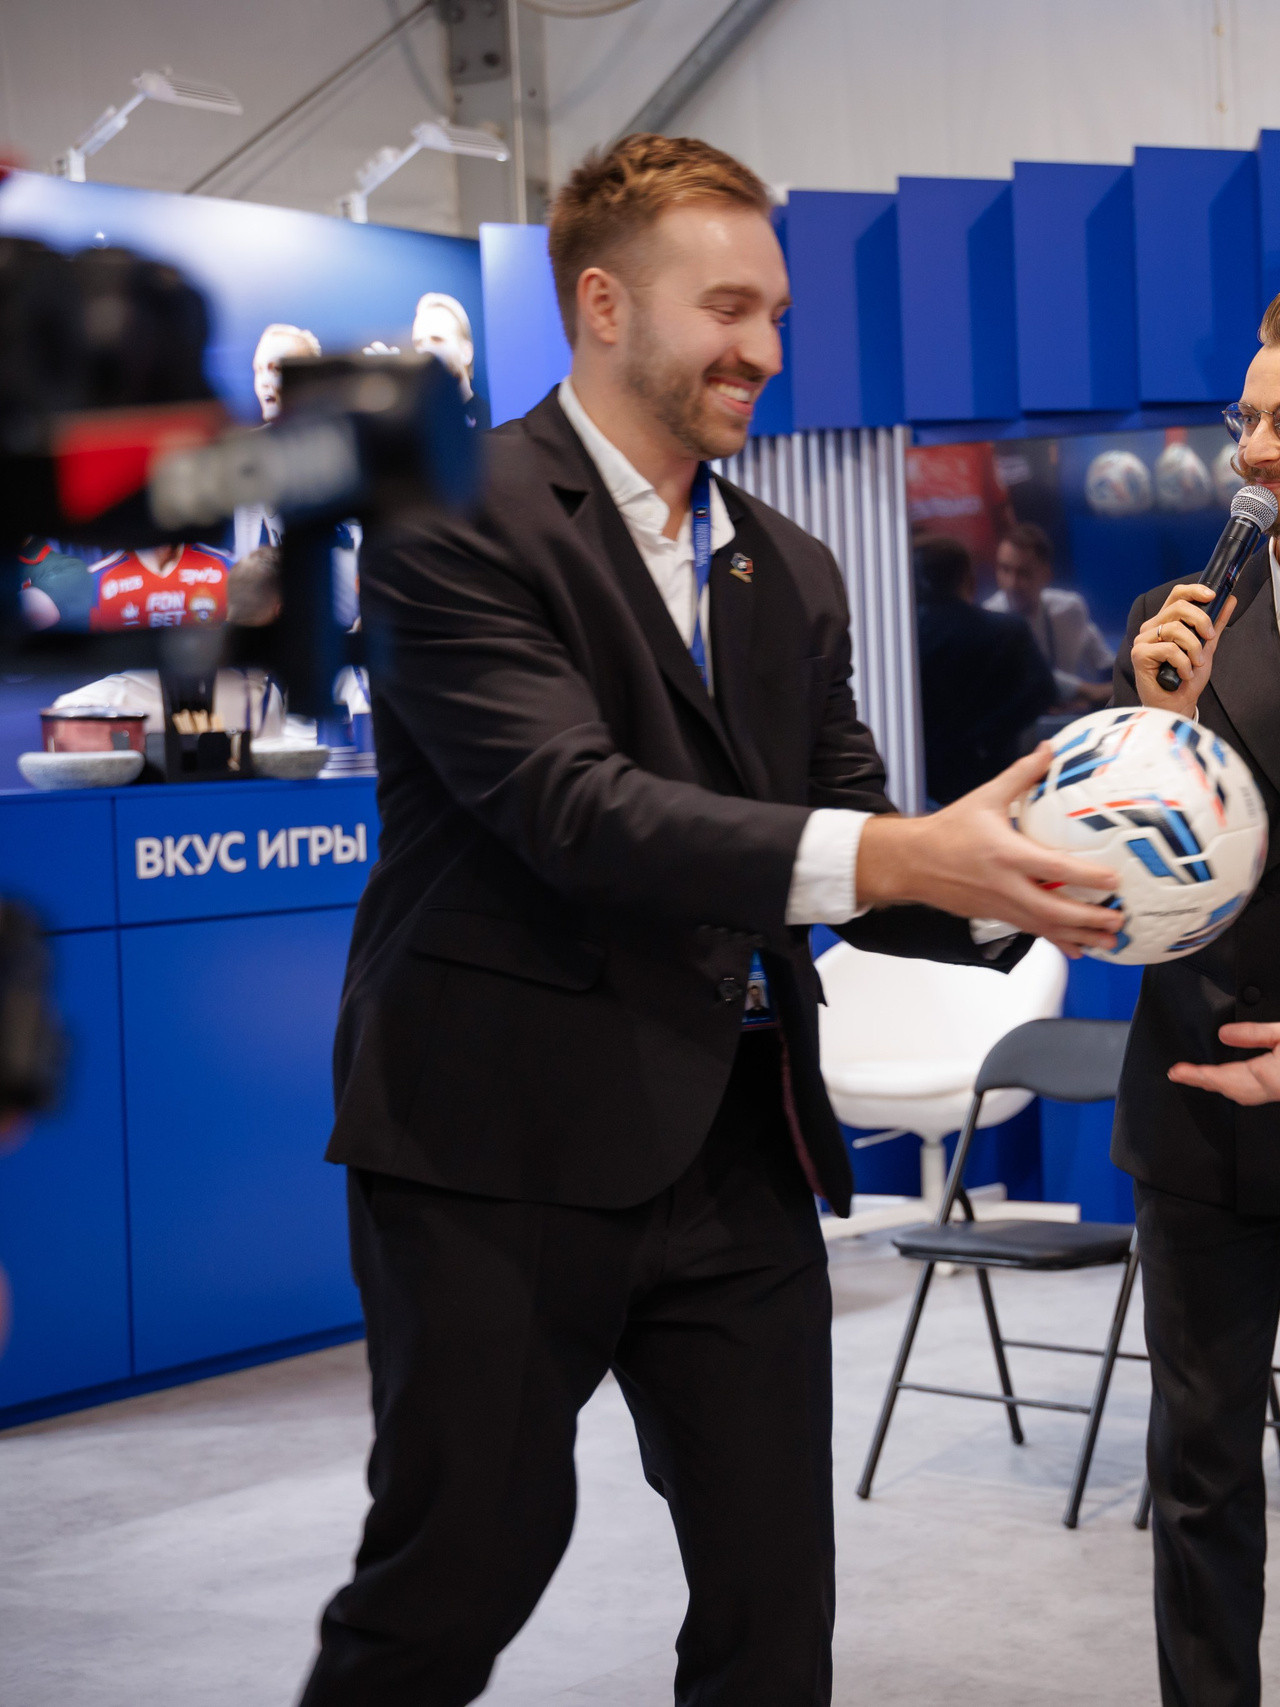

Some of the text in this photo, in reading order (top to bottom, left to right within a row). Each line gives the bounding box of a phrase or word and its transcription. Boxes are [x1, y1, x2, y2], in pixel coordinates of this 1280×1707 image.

[149, 611, 186, 627] BET
[136, 823, 367, 879] ВКУС ИГРЫ
